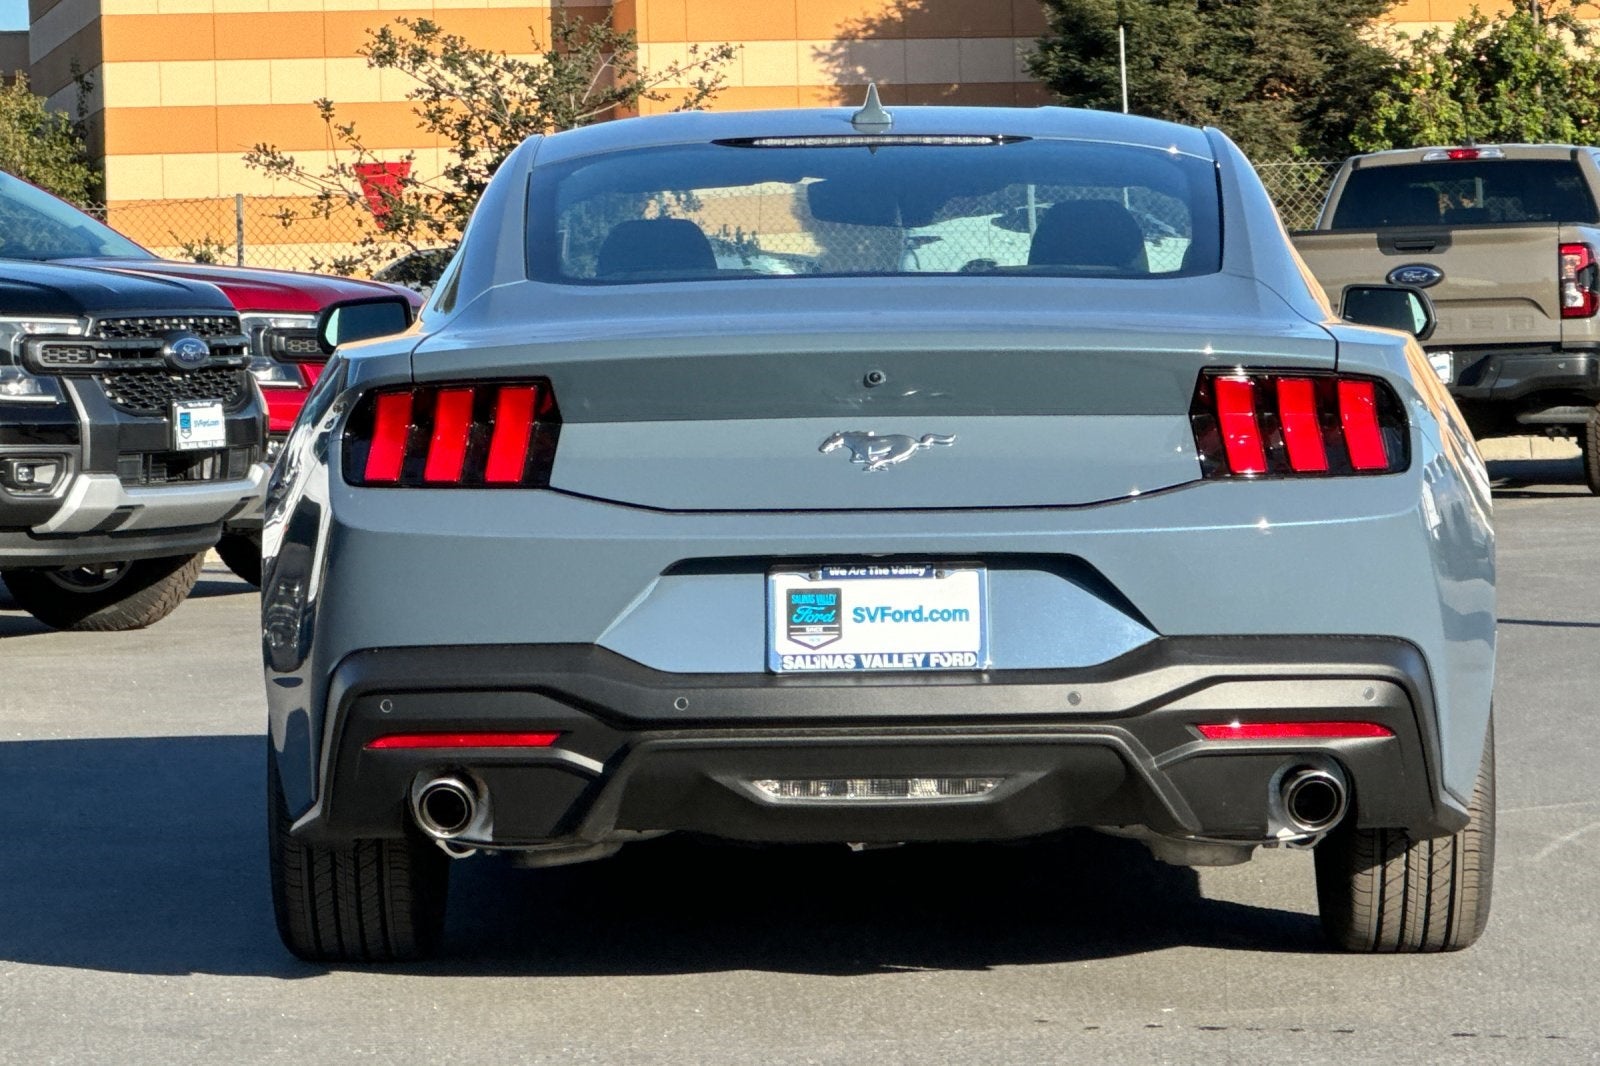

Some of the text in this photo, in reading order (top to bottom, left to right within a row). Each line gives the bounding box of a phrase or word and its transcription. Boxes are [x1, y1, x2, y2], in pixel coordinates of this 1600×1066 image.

[848, 566, 866, 576] Are
[868, 566, 890, 576] The
[791, 593, 837, 606] SALINAS VALLEY
[792, 605, 836, 624] Ford
[852, 605, 970, 623] SVFord.com
[782, 651, 978, 670] SALINAS VALLEY FORD
